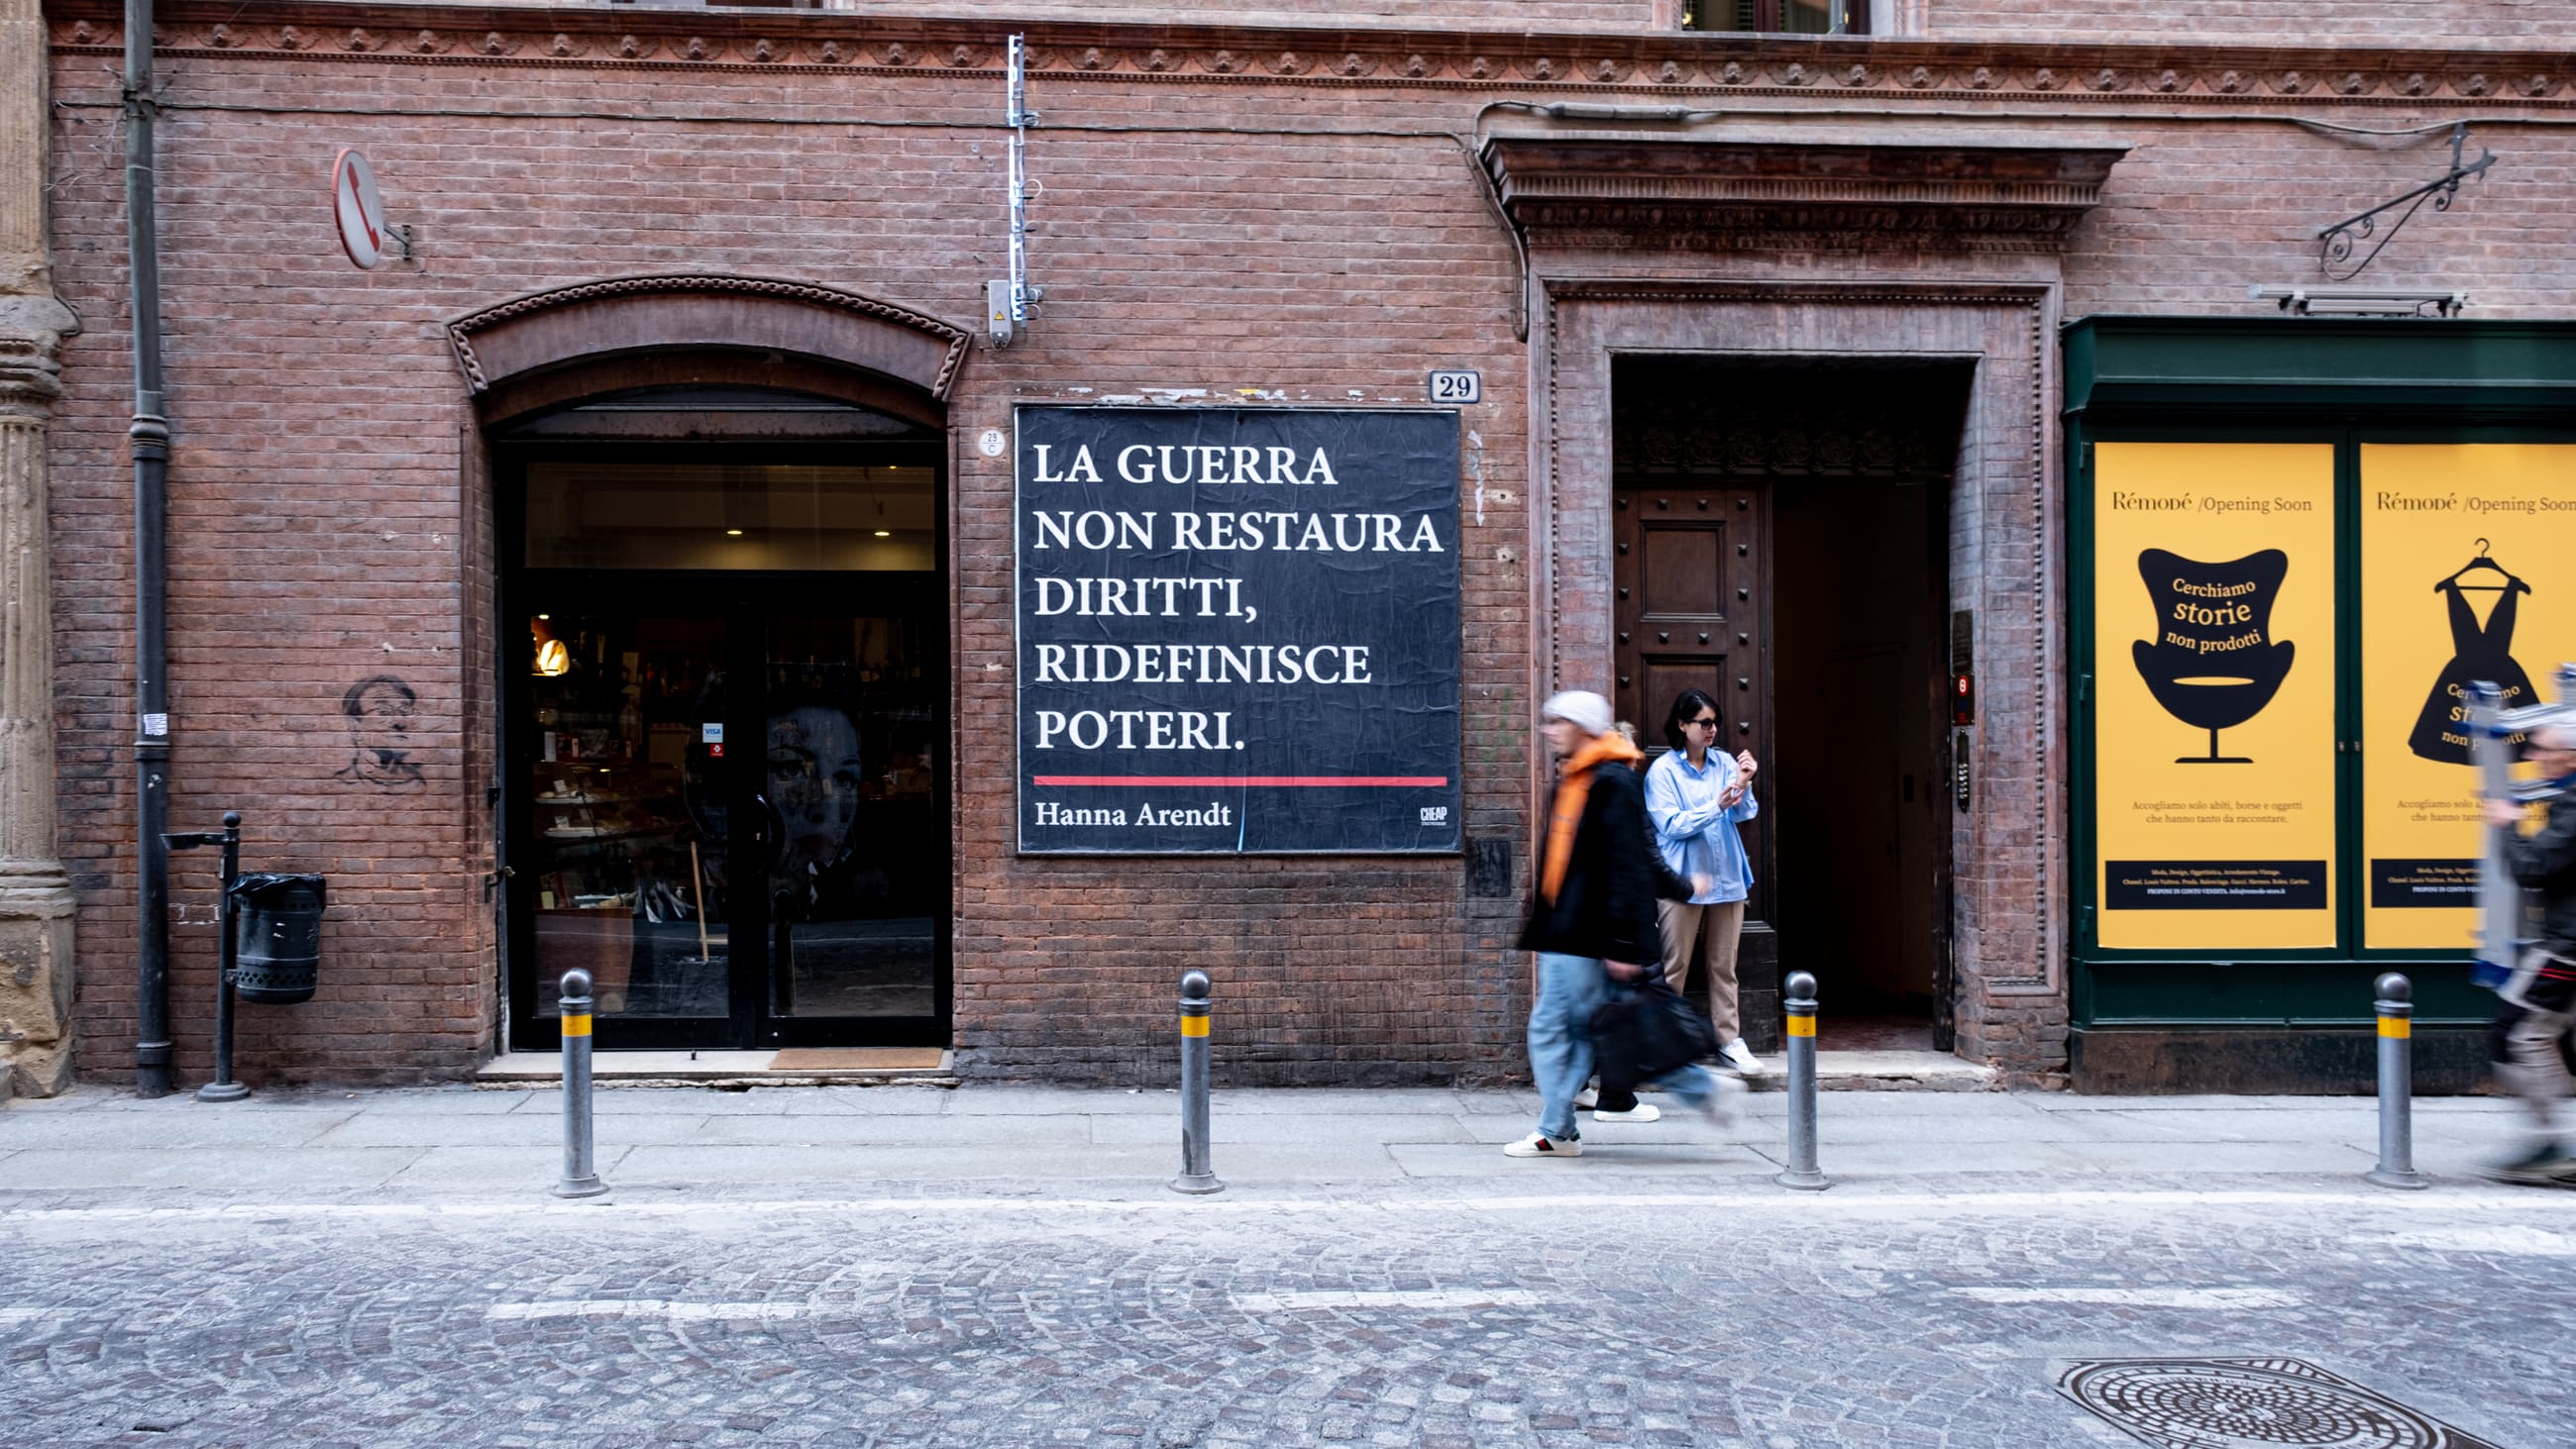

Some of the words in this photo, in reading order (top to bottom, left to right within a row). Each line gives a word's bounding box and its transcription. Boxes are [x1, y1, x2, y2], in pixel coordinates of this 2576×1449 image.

[1439, 374, 1472, 398] 29
[987, 433, 998, 442] 29
[988, 445, 996, 454] C
[1032, 444, 1104, 483] LA
[1117, 445, 1339, 486] GUERRA
[2274, 497, 2312, 511] Soon
[2539, 497, 2576, 511] Soon
[1032, 511, 1157, 551] NON
[1171, 512, 1445, 553] RESTAURA
[2172, 577, 2257, 598] Cerchiamo
[1034, 577, 1257, 624] DIRITTI,
[2173, 601, 2252, 626] storie
[2166, 631, 2197, 650] non
[2199, 629, 2263, 655] prodotti
[1034, 645, 1372, 684] RIDEFINISCE
[1034, 710, 1245, 751] POTERI.
[2441, 731, 2468, 746] non
[1034, 802, 1127, 827] Hanna
[1134, 801, 1233, 827] Arendt
[1420, 806, 1448, 821] CHEAP
[2132, 800, 2186, 811] Accogliamo
[2189, 800, 2207, 809] solo
[2235, 800, 2261, 809] borse
[2146, 814, 2163, 823] che
[2165, 814, 2196, 823] hanno
[2222, 814, 2234, 823] da
